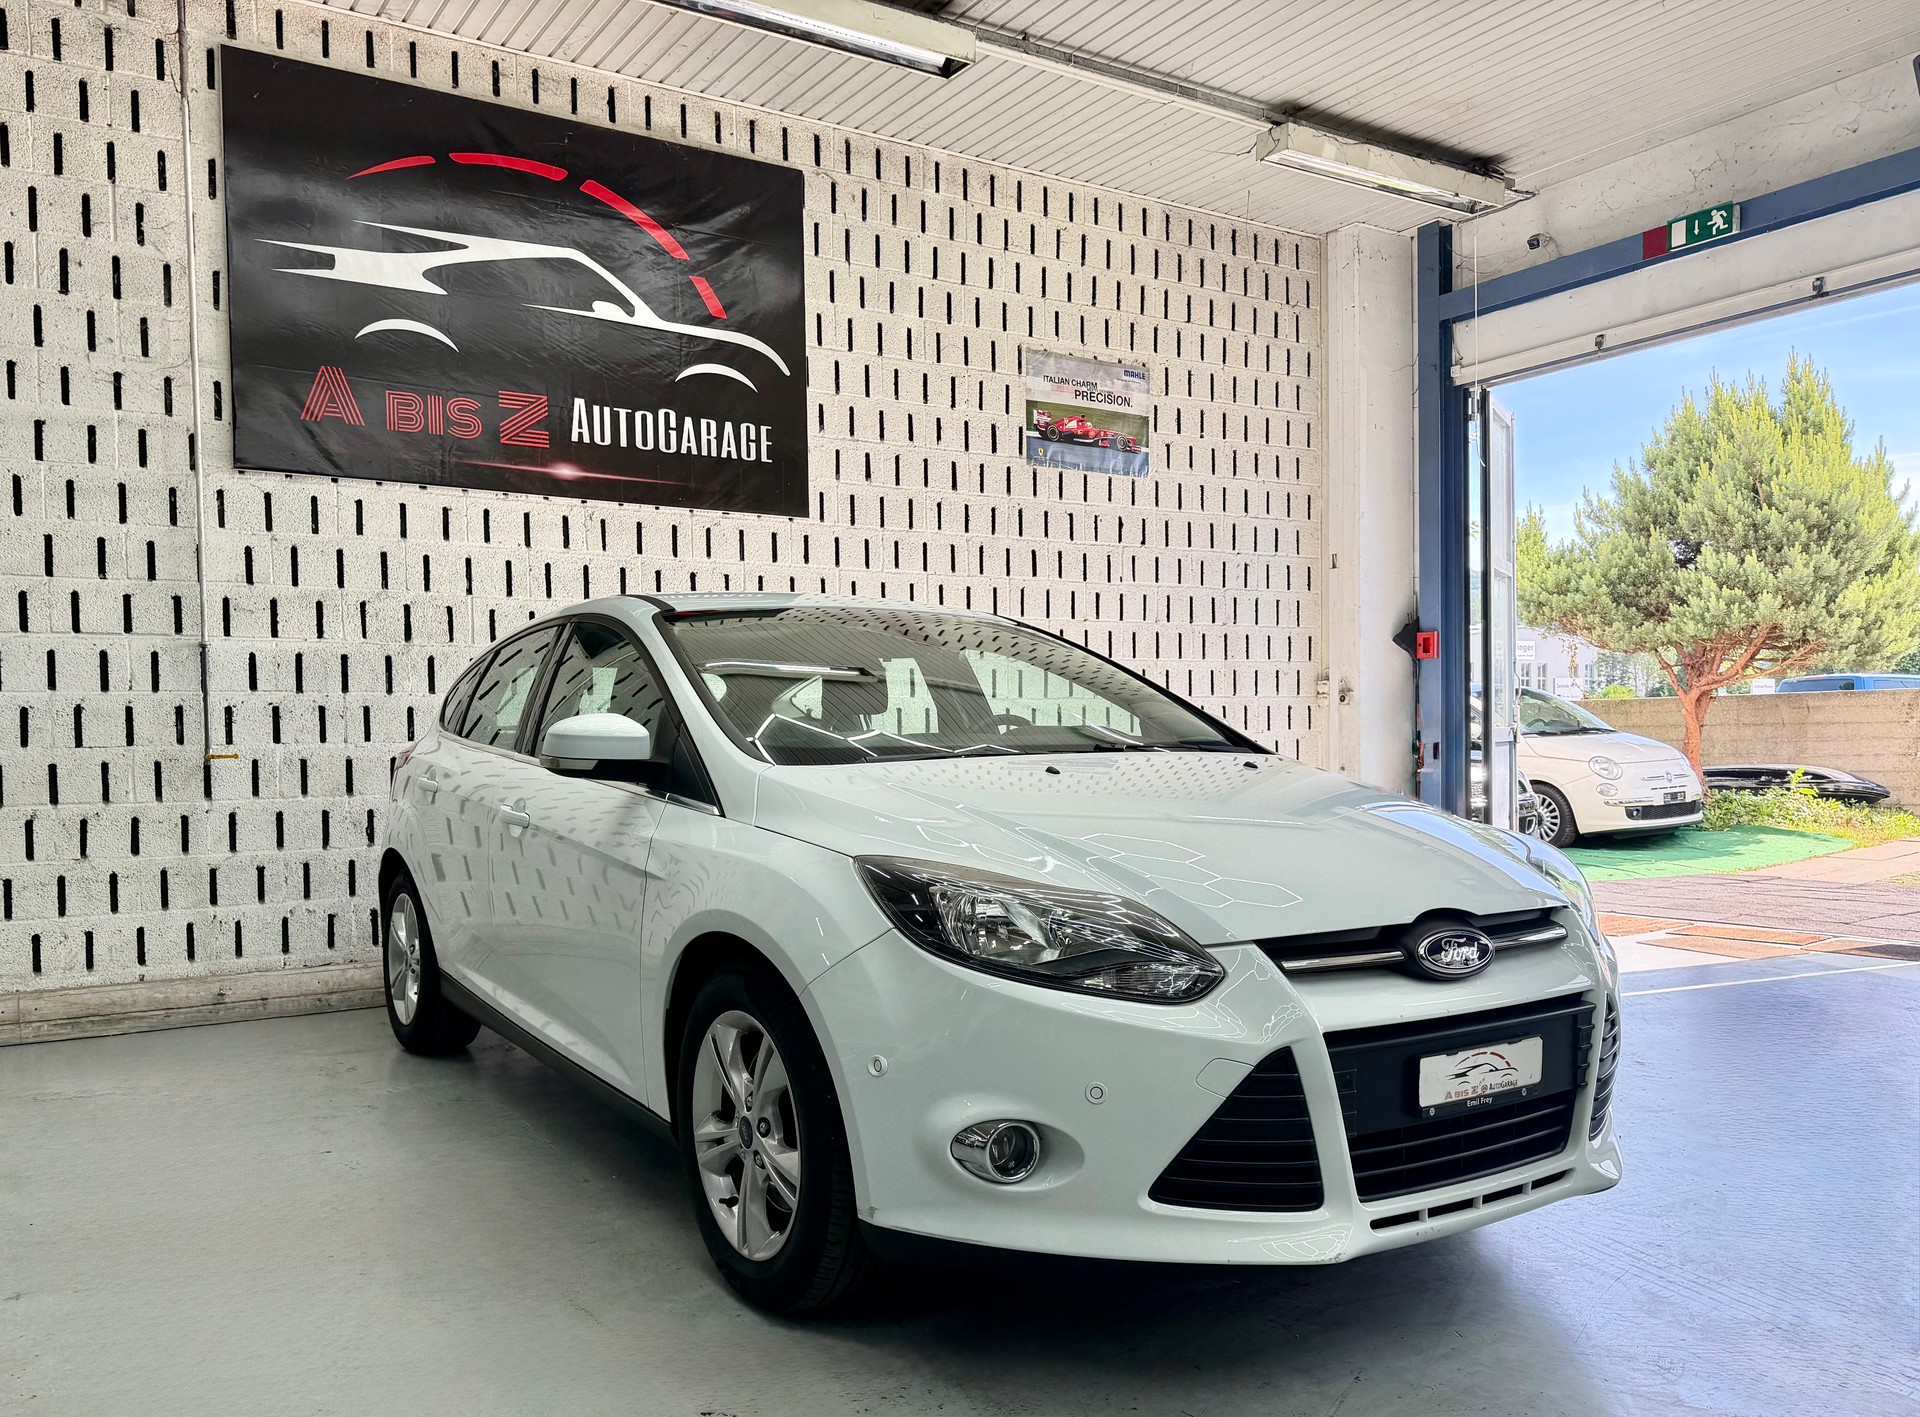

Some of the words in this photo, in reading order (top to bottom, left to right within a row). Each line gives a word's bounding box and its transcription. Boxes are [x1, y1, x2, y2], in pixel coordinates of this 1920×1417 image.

[1043, 374, 1070, 386] ITALIAN
[1071, 379, 1098, 390] CHARM
[1123, 369, 1146, 380] MAHLE
[300, 365, 365, 427] A
[497, 389, 551, 448] Z
[1074, 389, 1133, 408] PRECISION.
[1441, 937, 1480, 962] Ford
[1444, 1091, 1453, 1100] A
[1466, 1098, 1480, 1107] Emil
[1480, 1096, 1493, 1105] Frey
